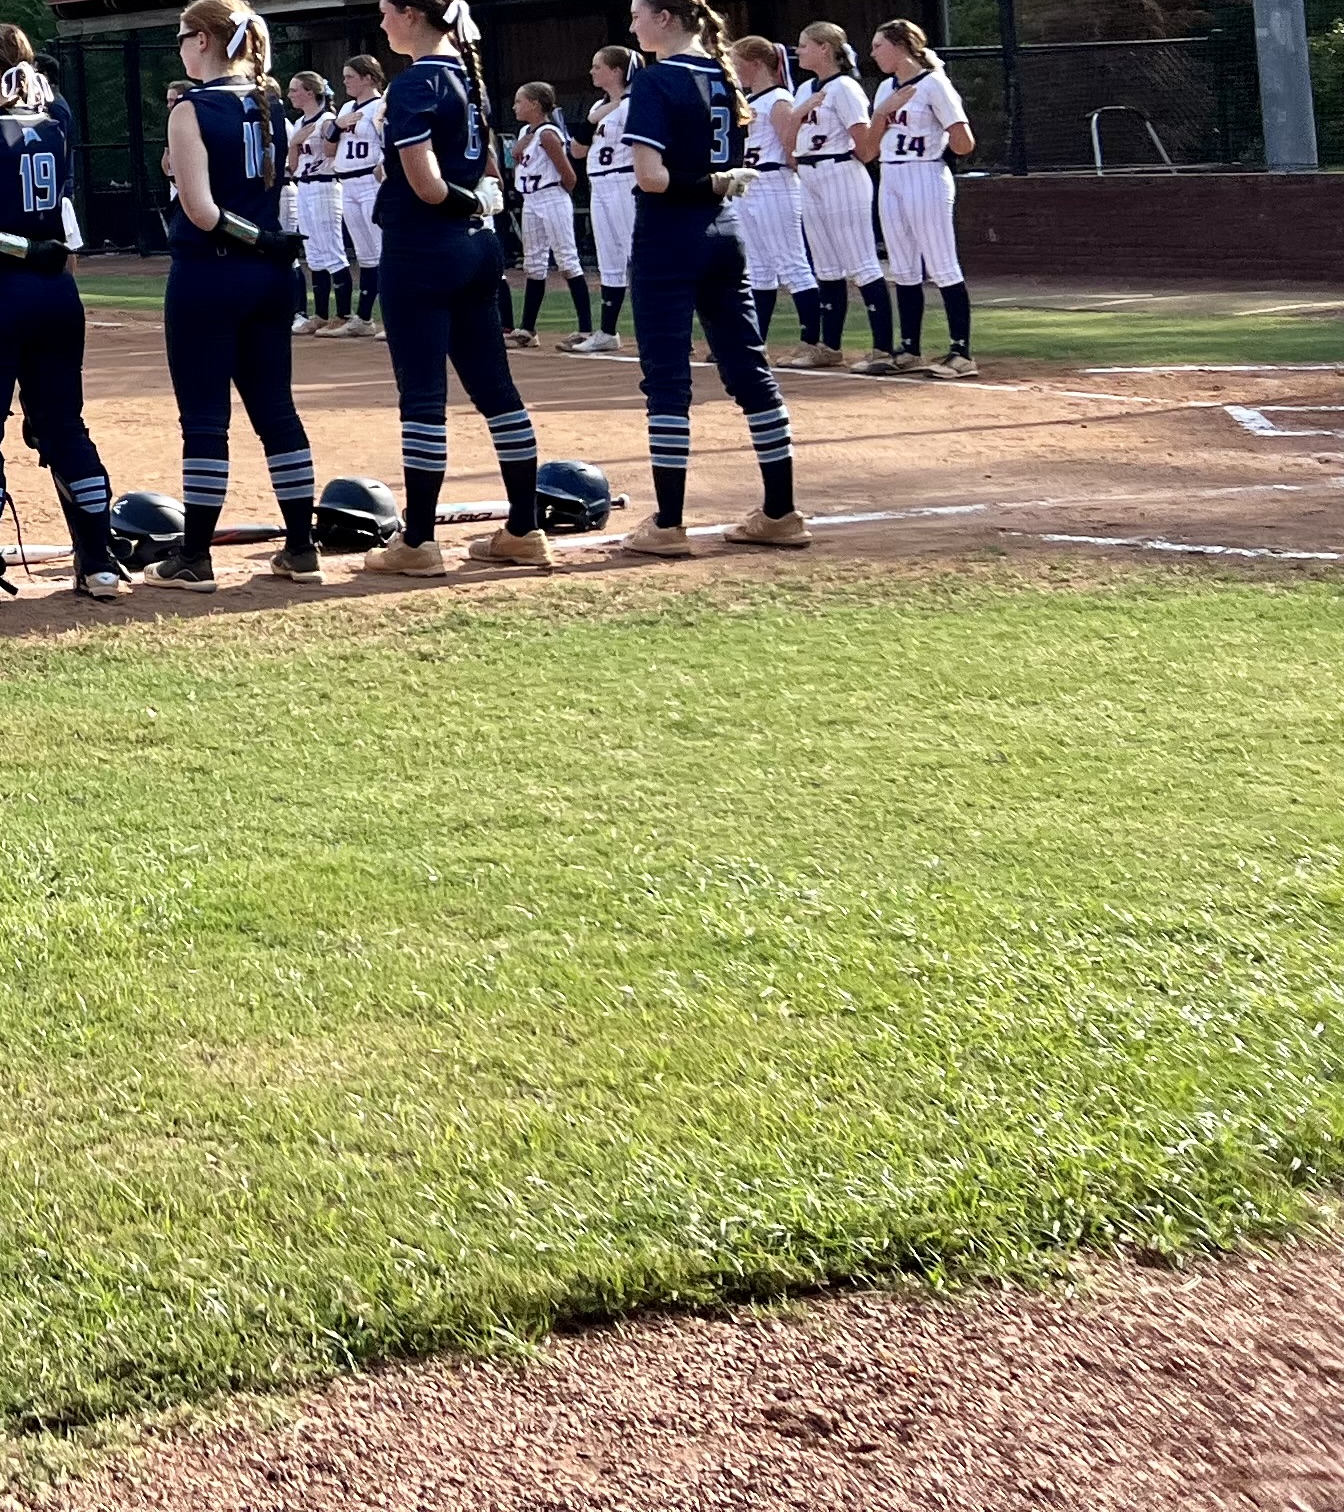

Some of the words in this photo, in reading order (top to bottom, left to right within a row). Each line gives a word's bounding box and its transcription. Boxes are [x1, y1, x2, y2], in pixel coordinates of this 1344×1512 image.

[710, 106, 730, 163] 3
[895, 133, 925, 157] 14
[345, 140, 369, 159] 10
[598, 146, 614, 166] 8
[19, 152, 57, 212] 19
[520, 174, 542, 194] 17
